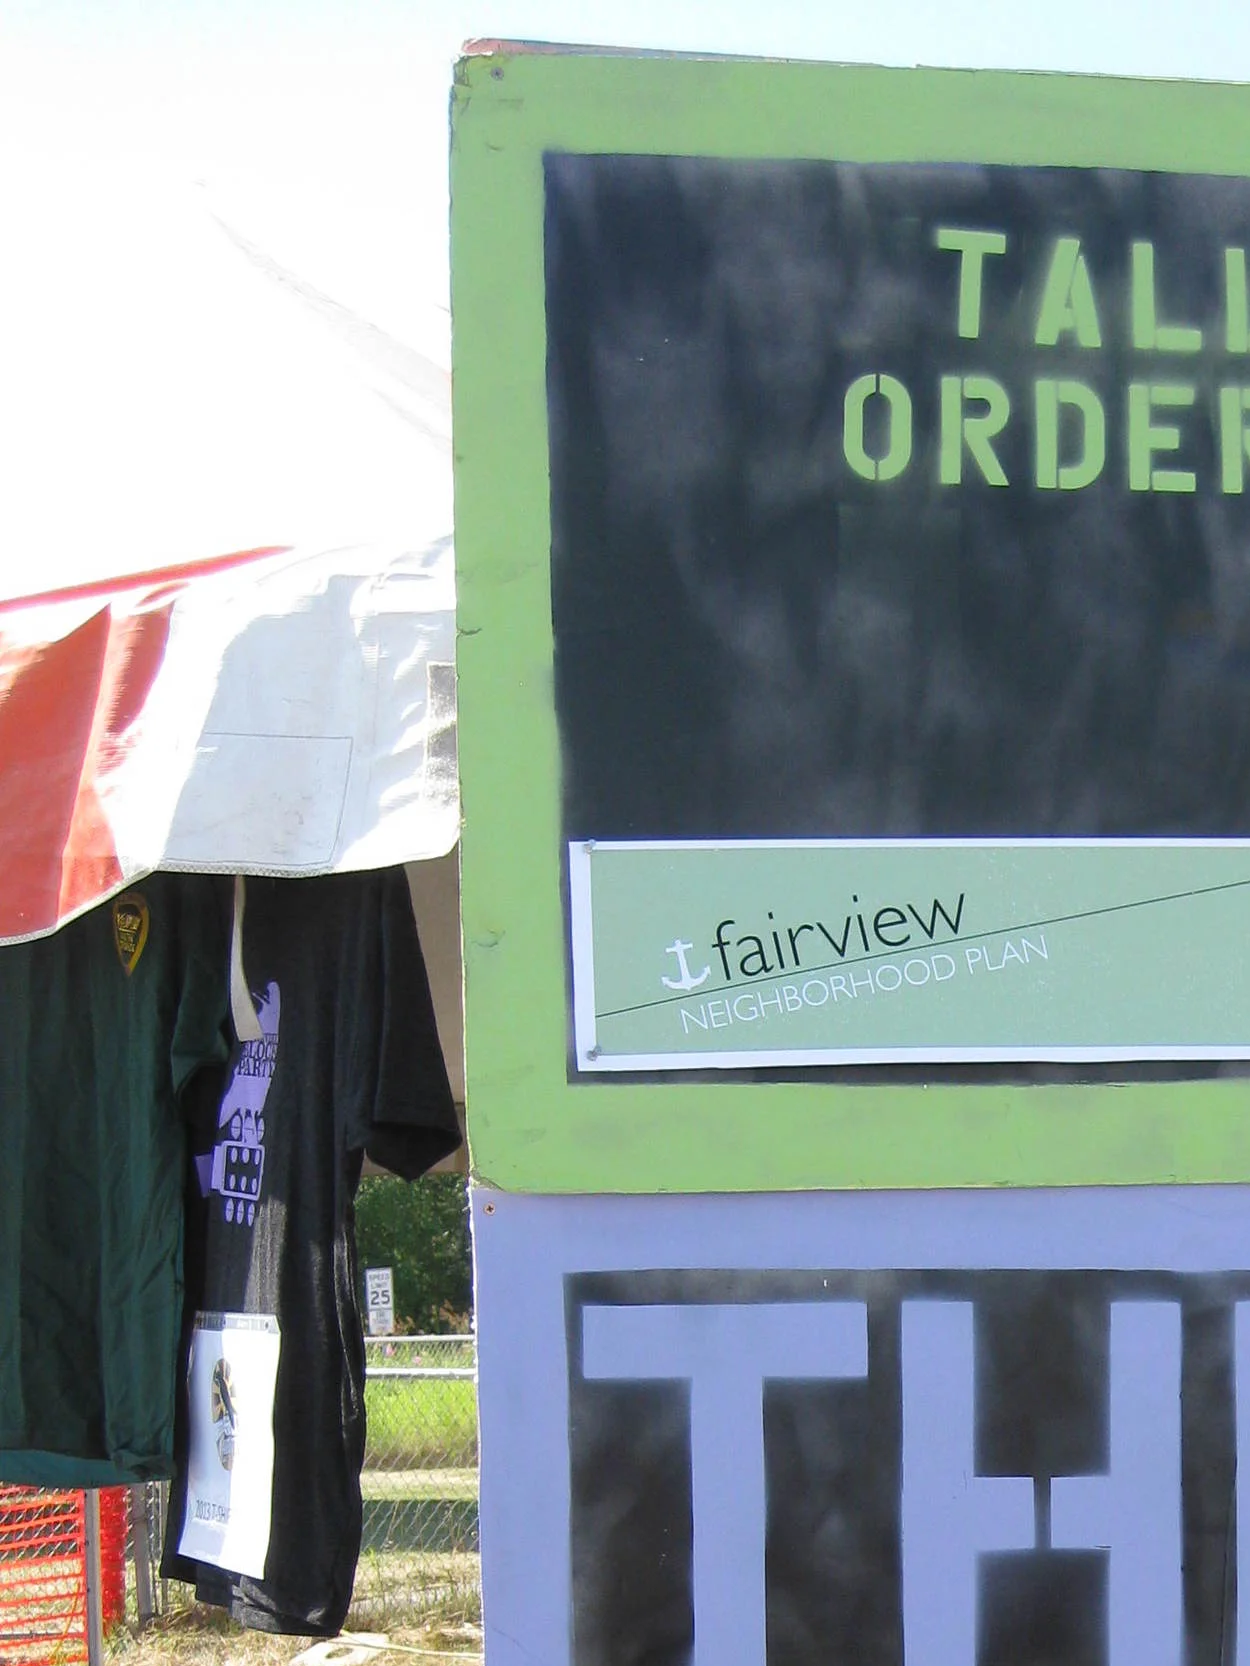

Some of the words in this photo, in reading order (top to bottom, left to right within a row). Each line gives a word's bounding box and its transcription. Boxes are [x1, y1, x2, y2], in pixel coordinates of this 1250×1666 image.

[711, 892, 966, 982] fairview
[679, 952, 957, 1035] NEIGHBORHOOD
[964, 934, 1050, 976] PLAN
[370, 1290, 391, 1306] 25
